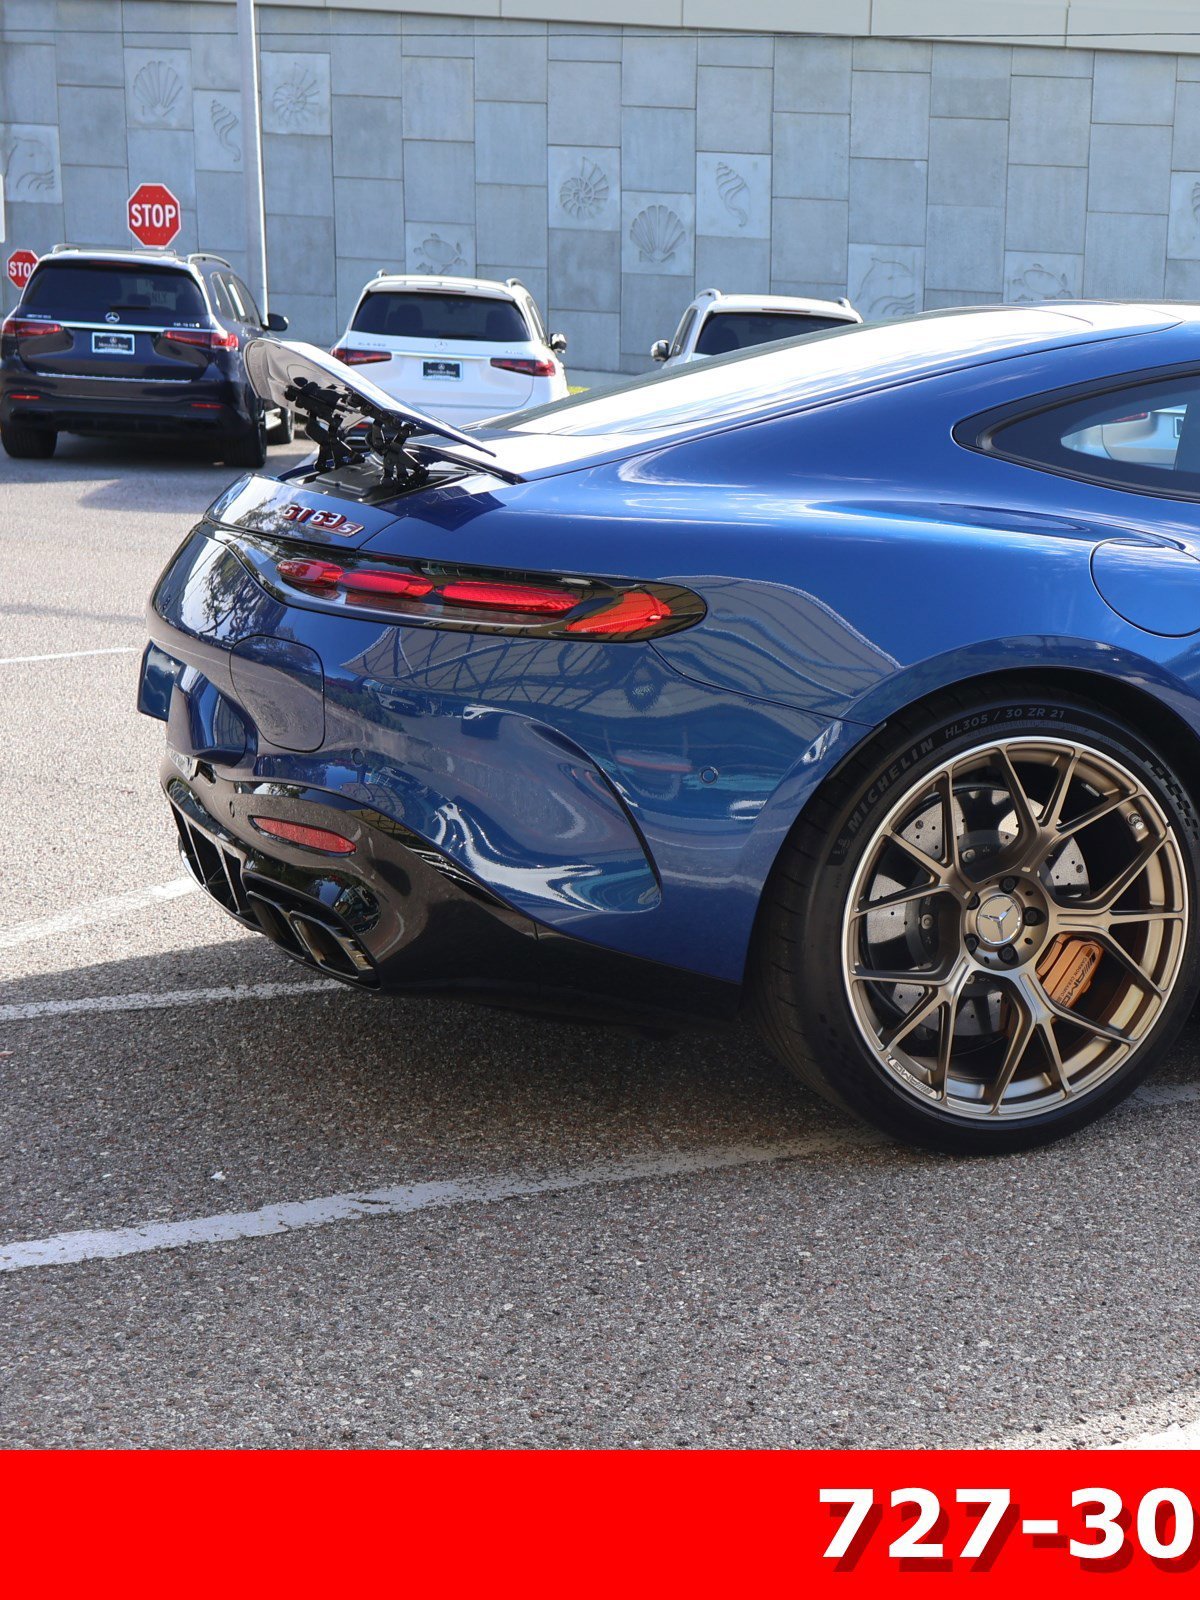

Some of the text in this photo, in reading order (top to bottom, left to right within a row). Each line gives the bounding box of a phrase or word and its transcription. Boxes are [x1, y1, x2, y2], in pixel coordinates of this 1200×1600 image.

[131, 203, 177, 228] STOP
[848, 737, 934, 832] MICHELIN
[945, 714, 988, 739] HL305
[1006, 709, 1022, 718] 30
[1028, 707, 1045, 717] ZR
[1050, 710, 1065, 719] 21
